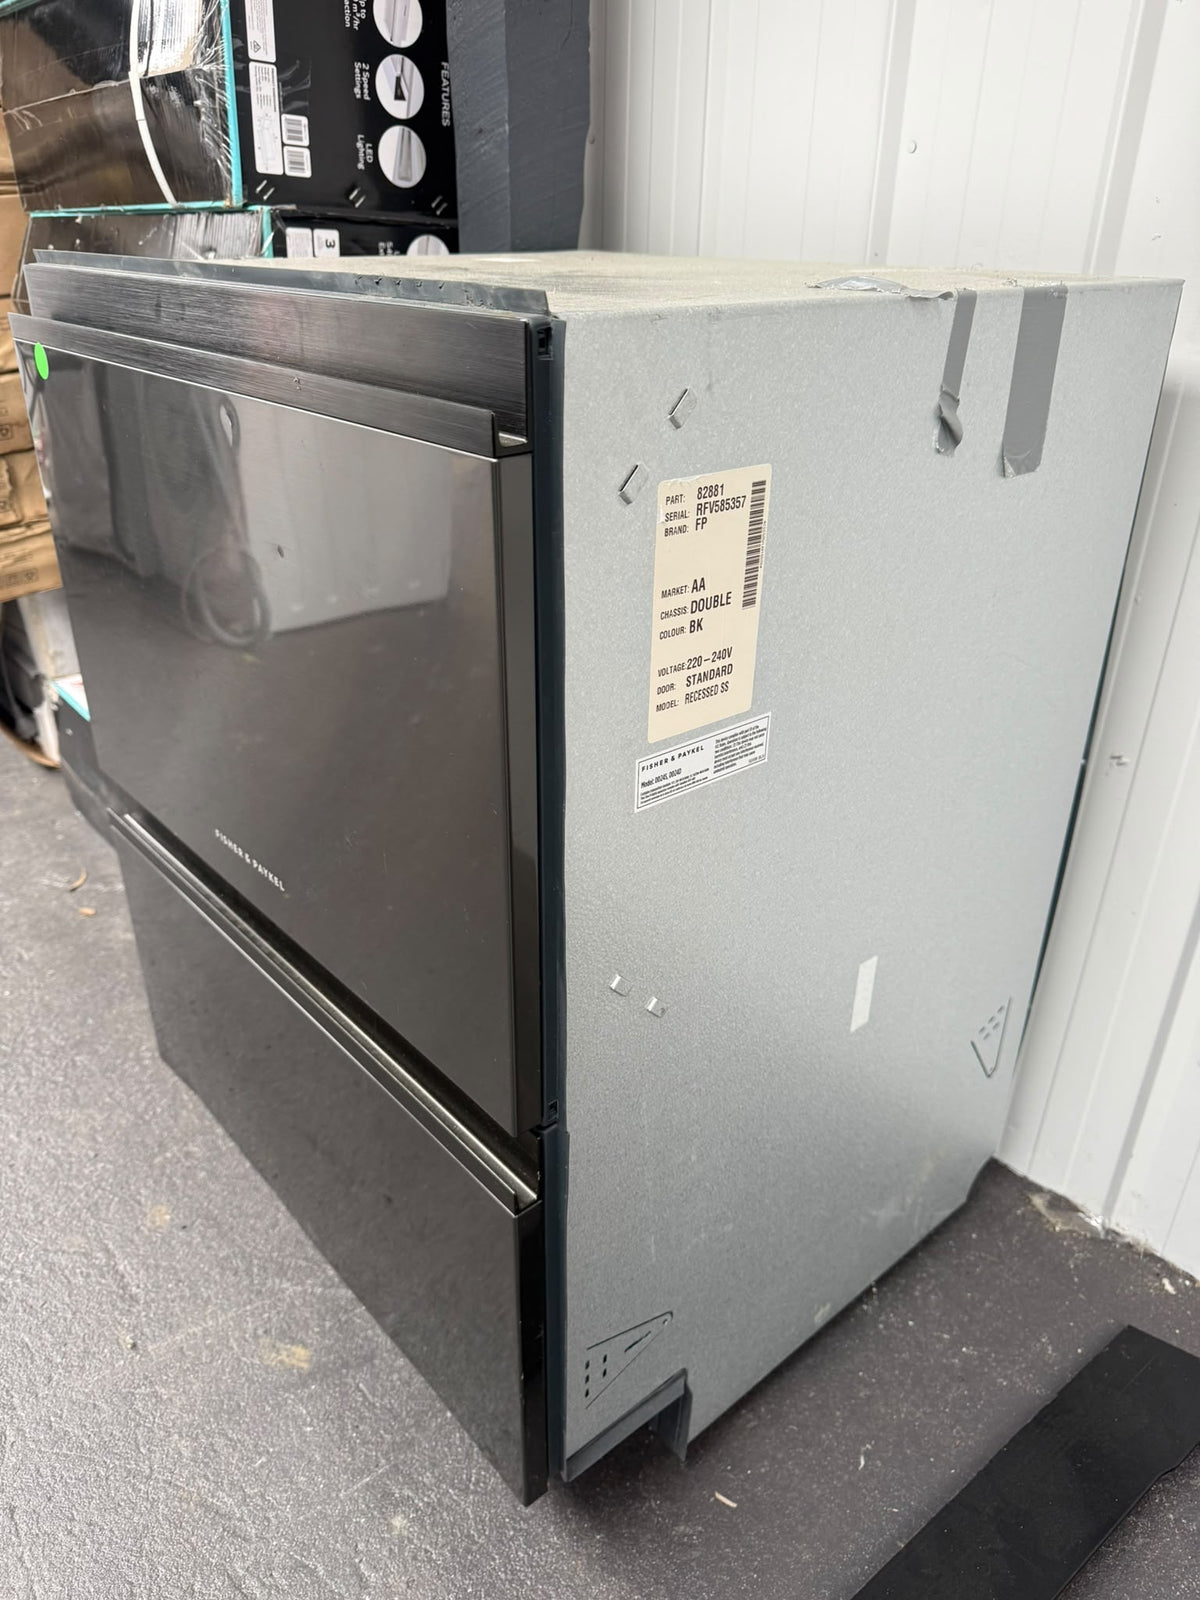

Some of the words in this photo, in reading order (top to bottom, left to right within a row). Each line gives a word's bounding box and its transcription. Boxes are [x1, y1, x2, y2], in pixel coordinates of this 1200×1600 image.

[361, 9, 366, 19] to
[354, 62, 362, 99] Settings
[362, 72, 370, 100] Speed
[441, 62, 450, 127] FEATURES
[357, 135, 365, 170] Lighting
[326, 239, 335, 248] 3
[665, 495, 686, 505] PART:
[697, 484, 725, 500] 82881
[664, 510, 690, 522] SERIAL:
[696, 495, 746, 516] RFV585357
[664, 525, 689, 537] BRAND:
[695, 517, 708, 531] FP
[661, 585, 690, 599] MARKET:
[691, 577, 706, 594] AA
[660, 607, 689, 620] CHASSIS:
[690, 592, 732, 614] DOUBLE
[659, 627, 686, 640] COLOUR:
[689, 618, 703, 634] BK
[657, 683, 676, 695] DOOR:
[686, 663, 733, 688] STANDARD
[658, 663, 687, 677] VOLTAGE:
[656, 700, 680, 712] MODEL:
[684, 685, 718, 704] RECESSED
[717, 681, 729, 694] SS
[642, 757, 669, 772] FISHER
[678, 745, 704, 759] PAYKEL
[641, 778, 654, 789] Model:
[215, 829, 243, 858] FISHER
[252, 859, 285, 891] PAYKEL
